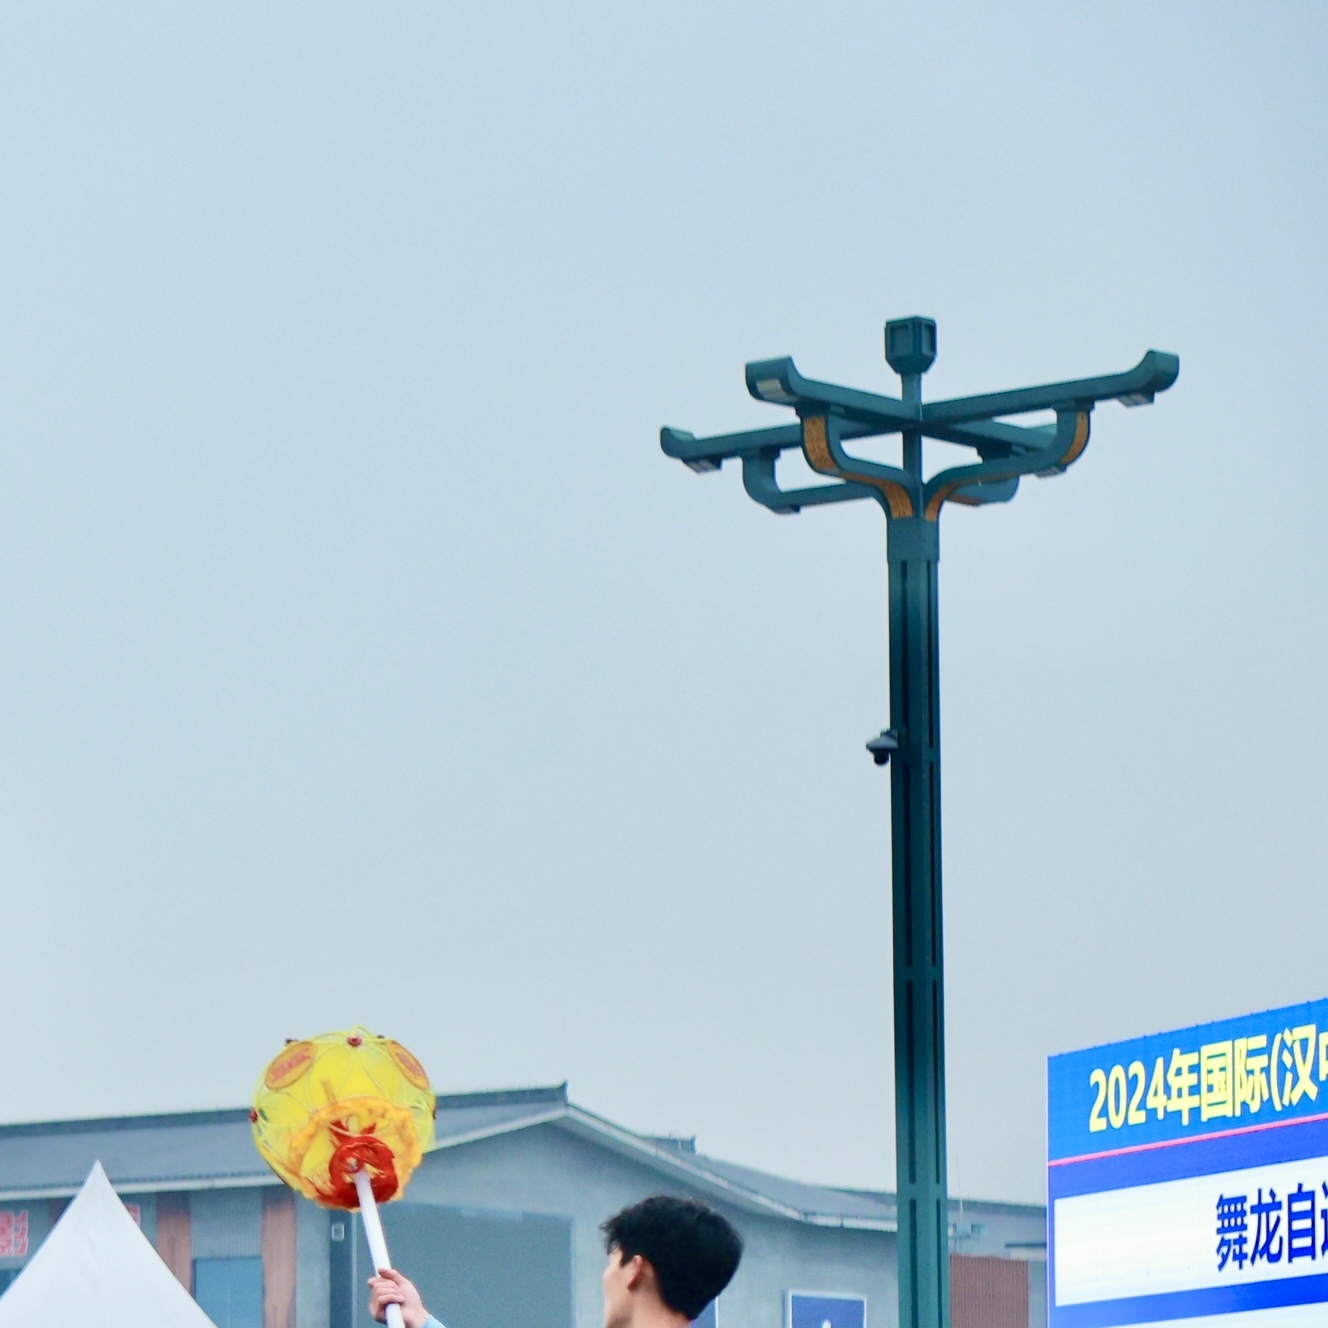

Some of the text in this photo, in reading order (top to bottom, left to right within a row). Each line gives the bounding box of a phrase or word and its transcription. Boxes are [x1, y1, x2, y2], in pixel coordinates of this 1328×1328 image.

[1088, 1023, 1328, 1133] 2024年国际(汉
[1215, 1180, 1328, 1272] 舞龙自
